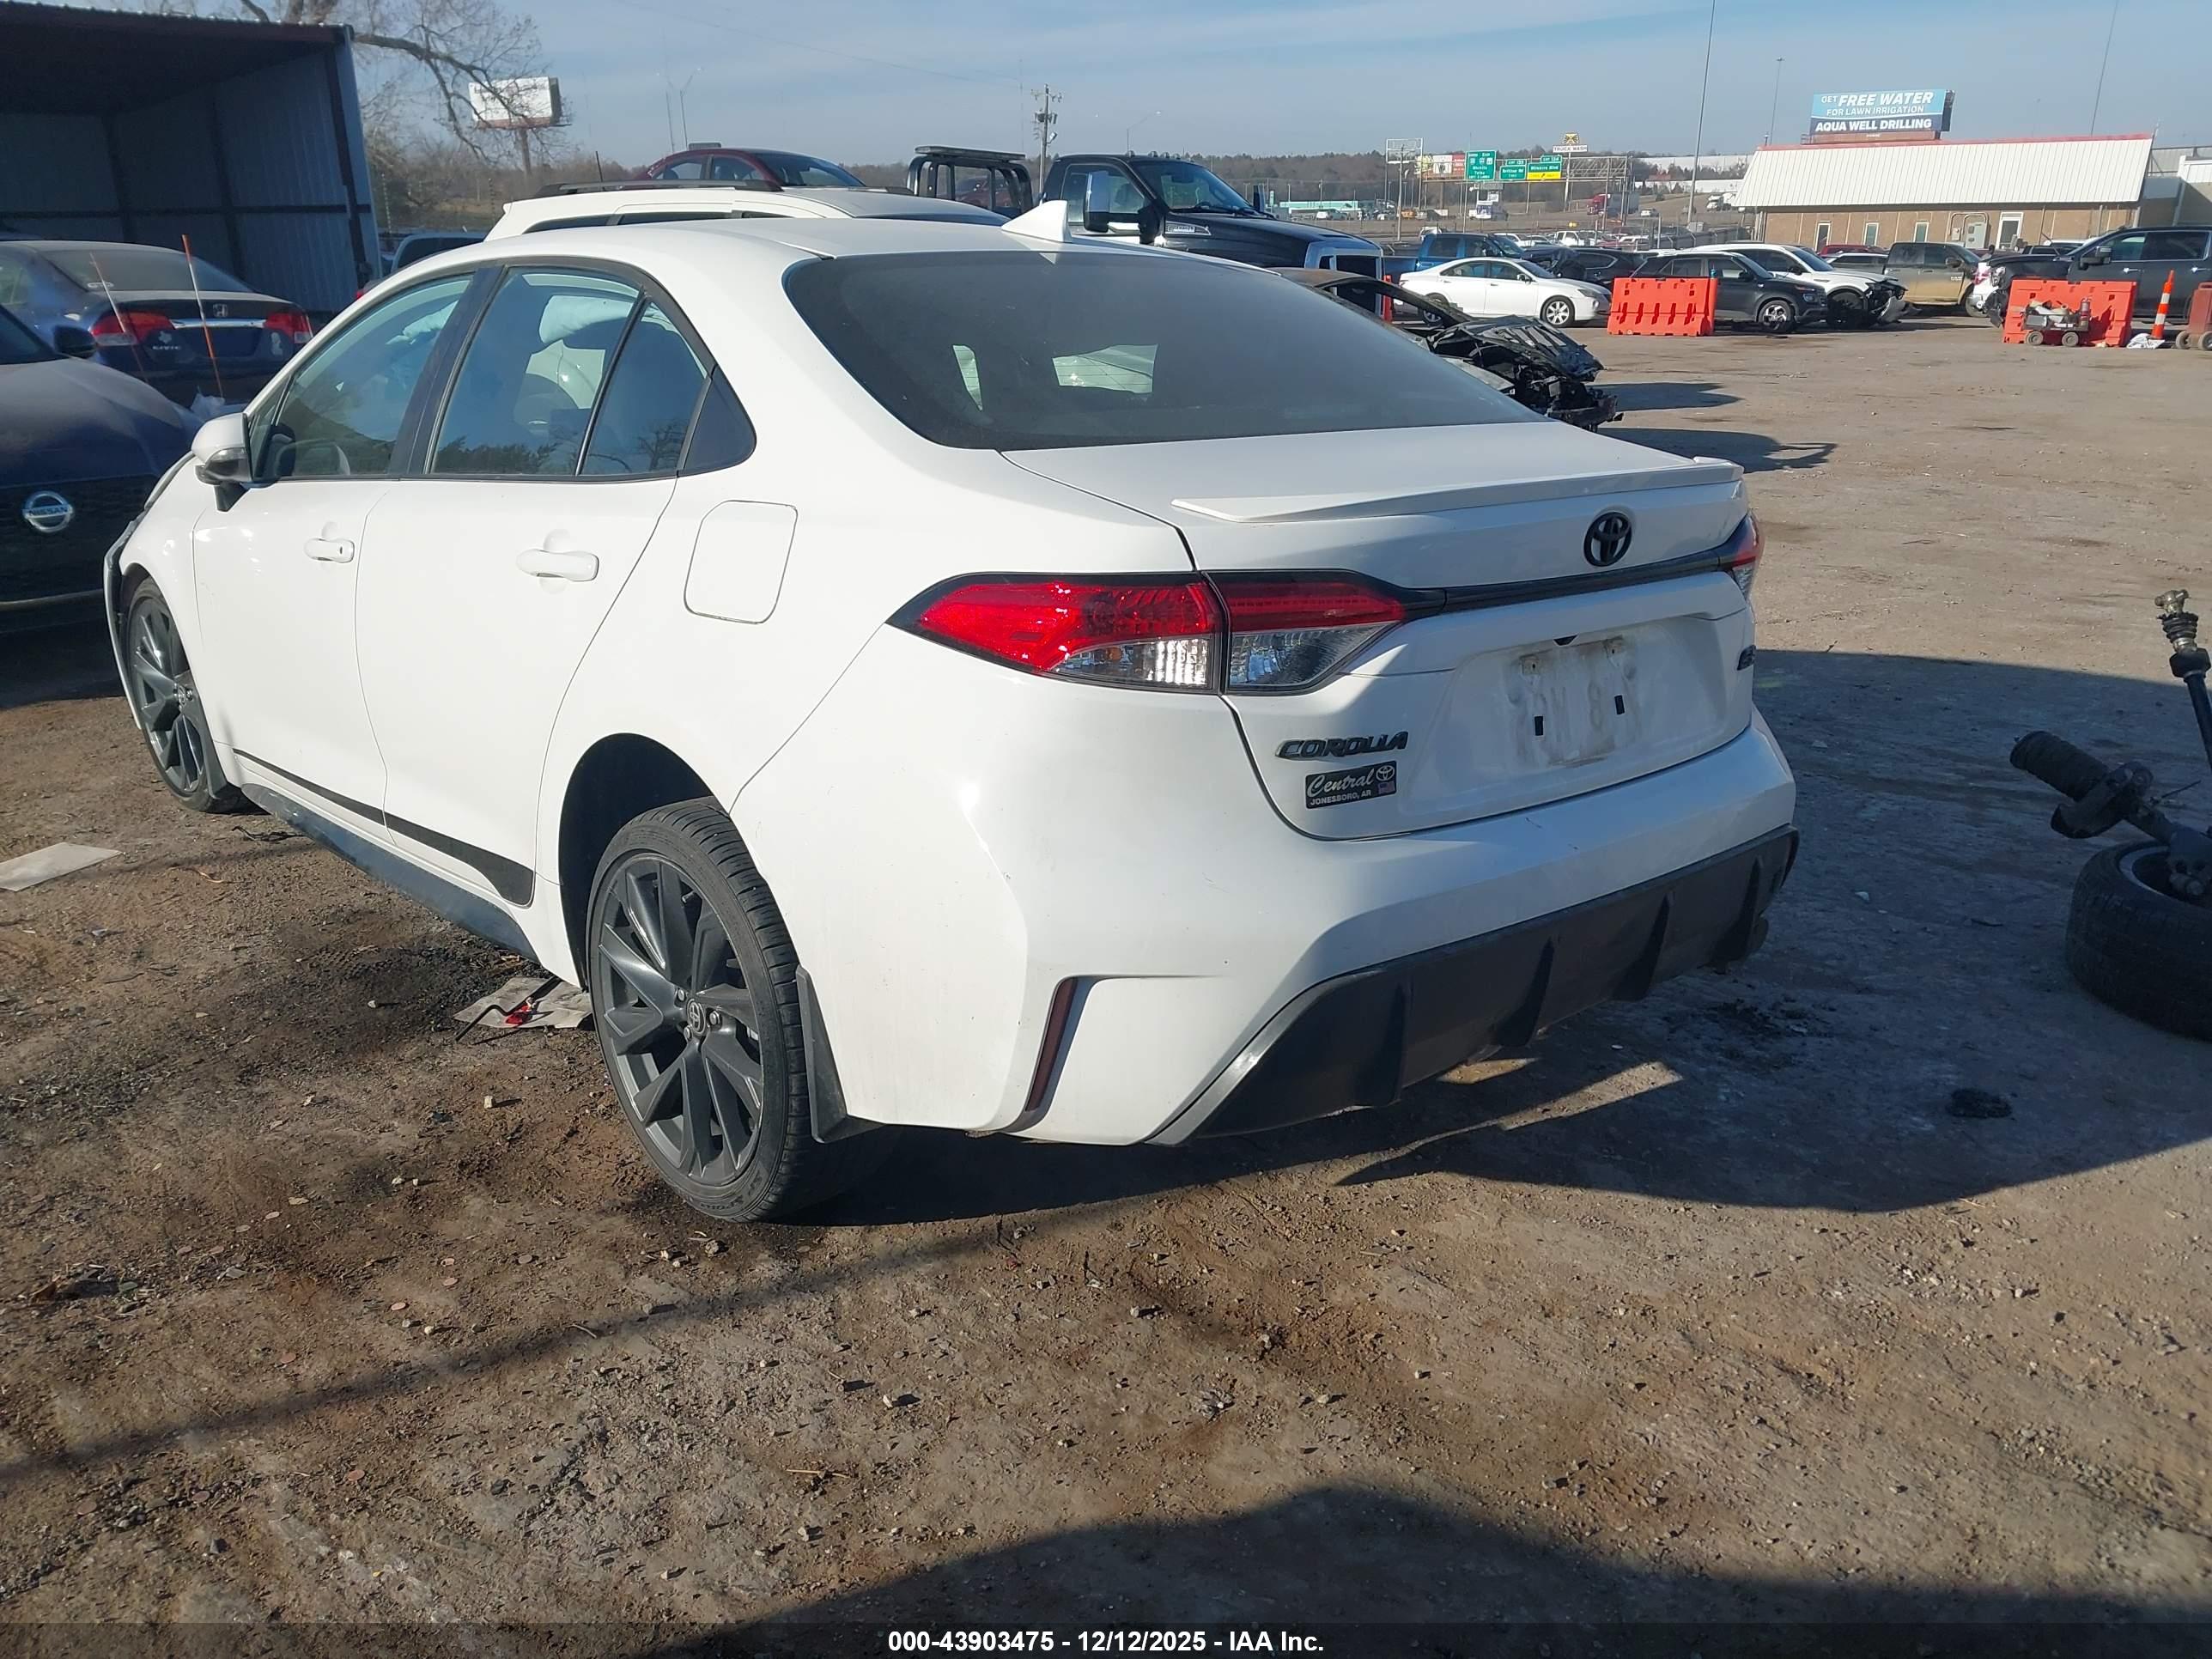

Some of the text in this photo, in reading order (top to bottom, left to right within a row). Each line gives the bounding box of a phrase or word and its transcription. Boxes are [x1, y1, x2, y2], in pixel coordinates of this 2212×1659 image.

[1838, 94, 1876, 106] FREE
[1880, 91, 1933, 105] WATER
[1873, 105, 1924, 114] IRRIGATION
[1814, 118, 1932, 131] AQUA WELL DRILLING
[1275, 731, 1409, 758] COROLLA
[1307, 768, 1376, 798] Central
[1310, 792, 1360, 806] JONESBORO,
